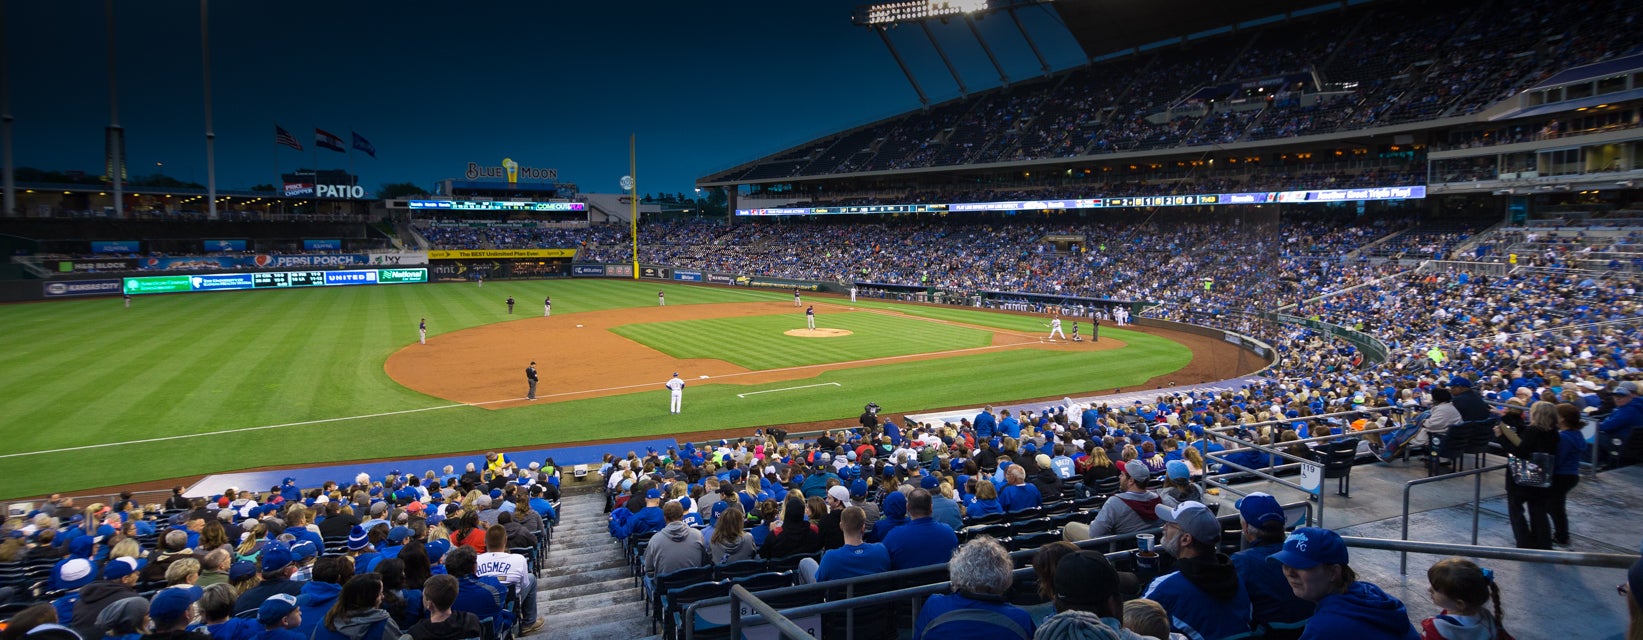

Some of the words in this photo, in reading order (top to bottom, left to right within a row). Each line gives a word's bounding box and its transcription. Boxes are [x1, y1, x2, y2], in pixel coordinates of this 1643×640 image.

[285, 188, 313, 196] CHOPPER
[316, 184, 364, 198] PATIO
[1318, 192, 1346, 200] Another
[1347, 190, 1368, 198] Great
[1370, 189, 1390, 199] Triple
[314, 256, 354, 265] PORCH
[1061, 467, 1070, 478] 5
[1302, 464, 1314, 473] 119
[1296, 540, 1307, 552] KC
[477, 562, 511, 576] HOSMER
